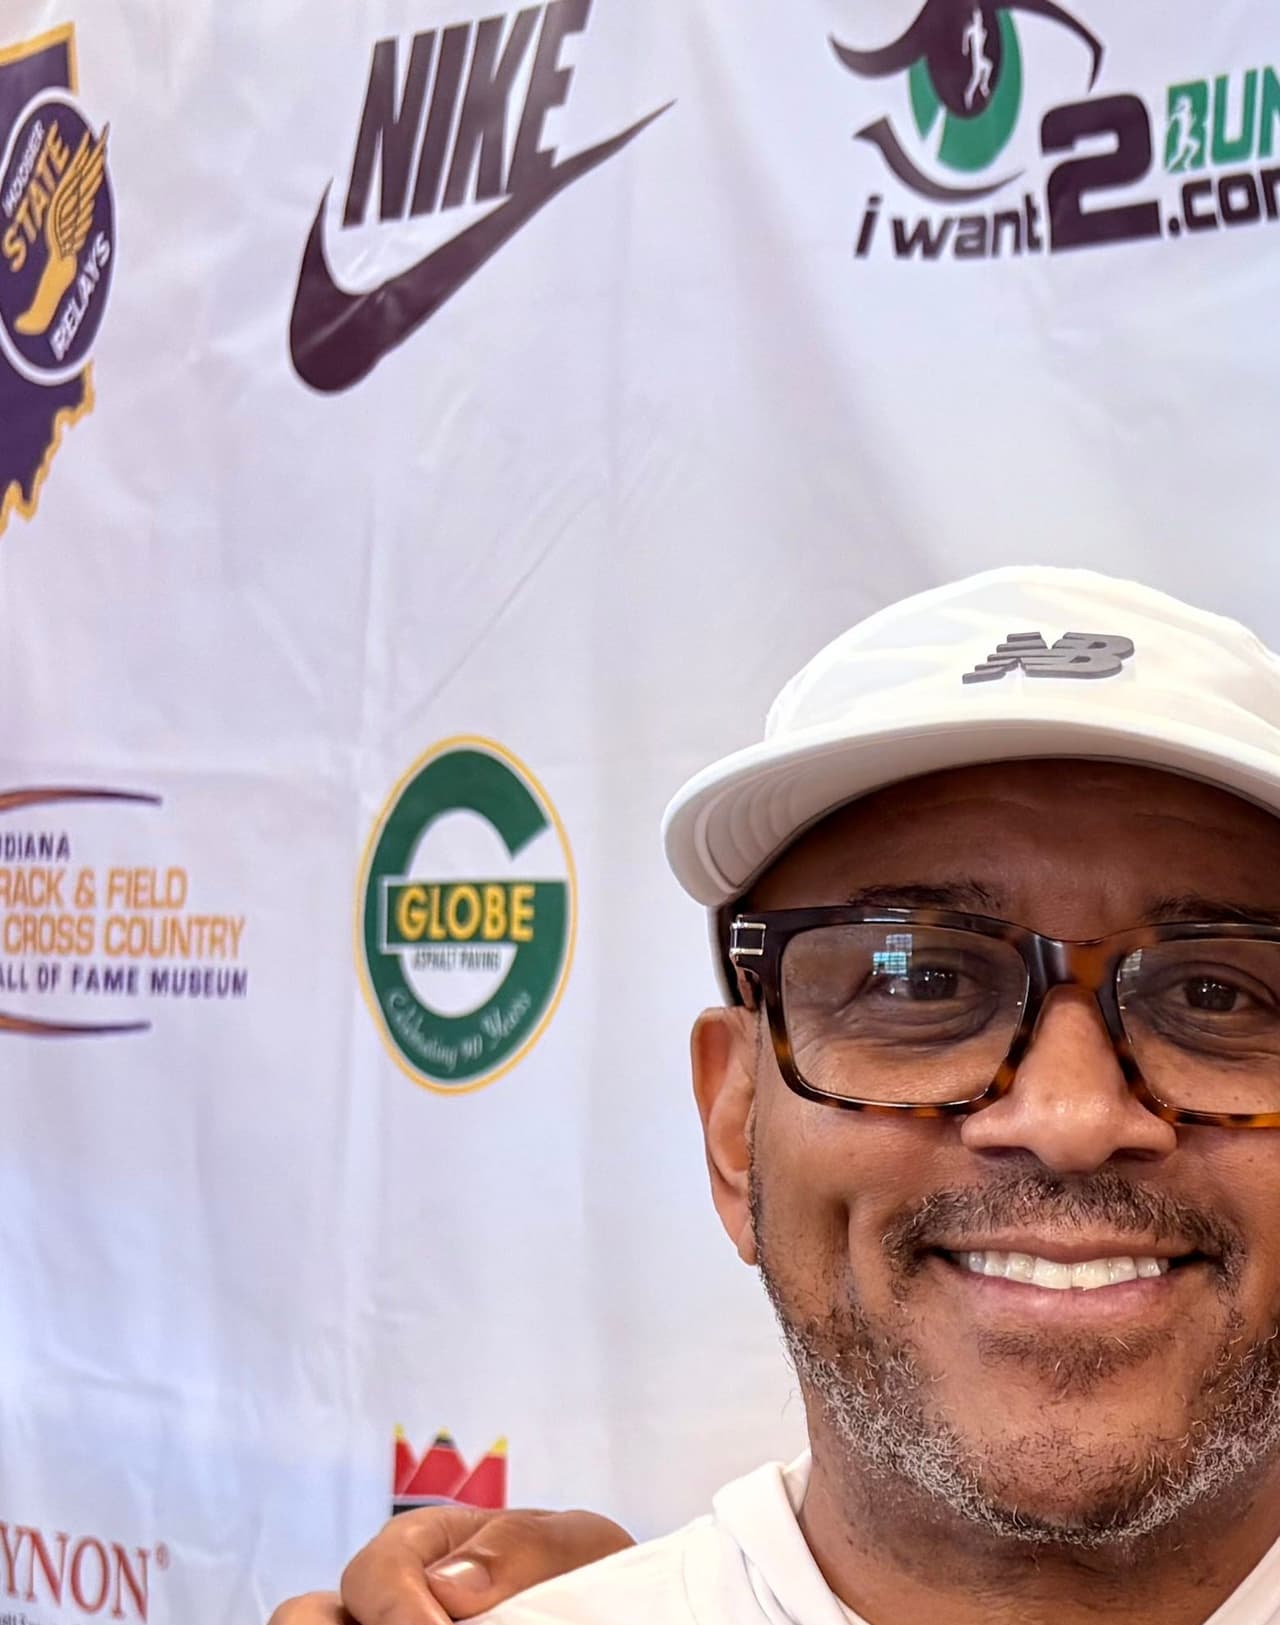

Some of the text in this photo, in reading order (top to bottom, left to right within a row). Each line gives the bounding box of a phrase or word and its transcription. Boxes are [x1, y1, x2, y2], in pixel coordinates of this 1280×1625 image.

[341, 0, 594, 231] NIKE
[3, 119, 46, 218] HOOSIER
[3, 120, 69, 273] STATE
[50, 231, 110, 360] RELAYS
[0, 832, 70, 862] DIANA
[0, 866, 188, 911] RACK & FIELD
[396, 884, 535, 941] GLOBE
[3, 914, 247, 960] CROSS COUNTRY
[413, 951, 500, 973] ASPHALT PAVING
[37, 963, 60, 995] OF
[71, 965, 139, 997] FAME
[150, 966, 248, 1000] MUSEUM
[482, 990, 532, 1050] Years
